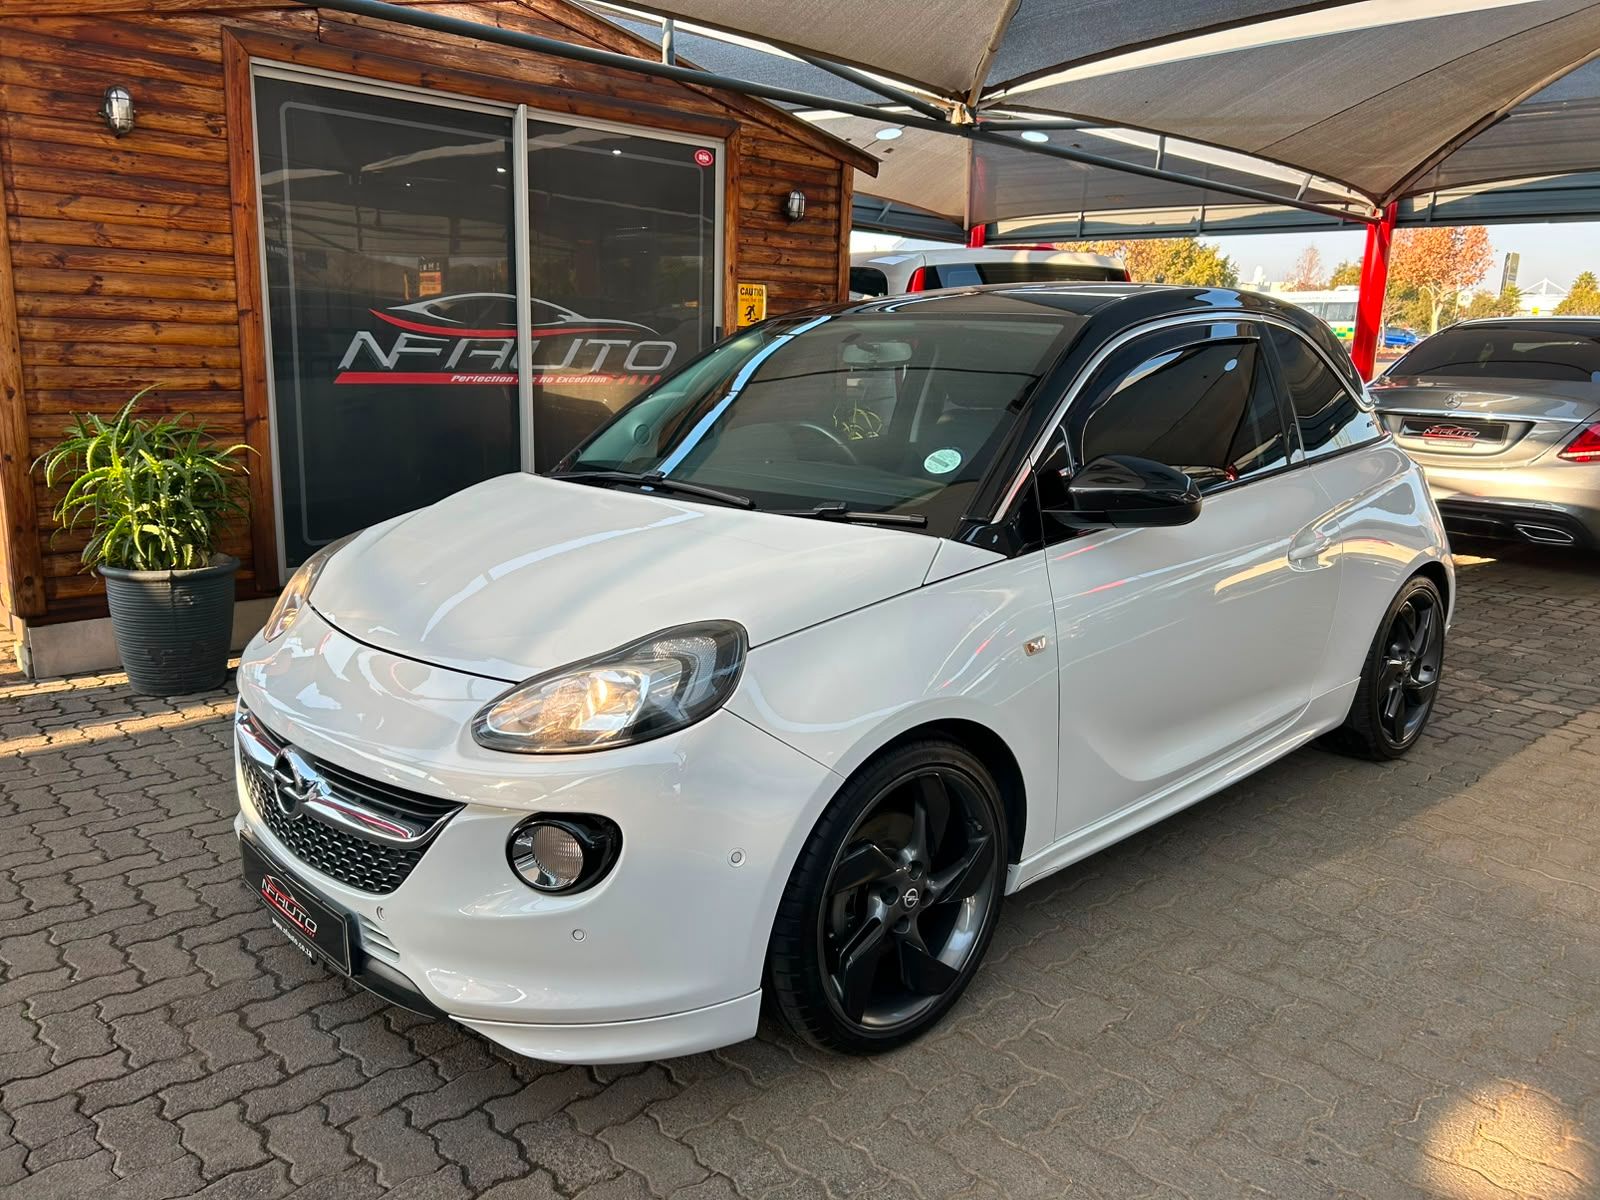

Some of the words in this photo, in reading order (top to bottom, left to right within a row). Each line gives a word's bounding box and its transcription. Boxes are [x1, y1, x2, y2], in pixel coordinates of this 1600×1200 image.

[450, 375, 514, 383] Perfection
[539, 376, 554, 384] No
[556, 375, 608, 384] Exception
